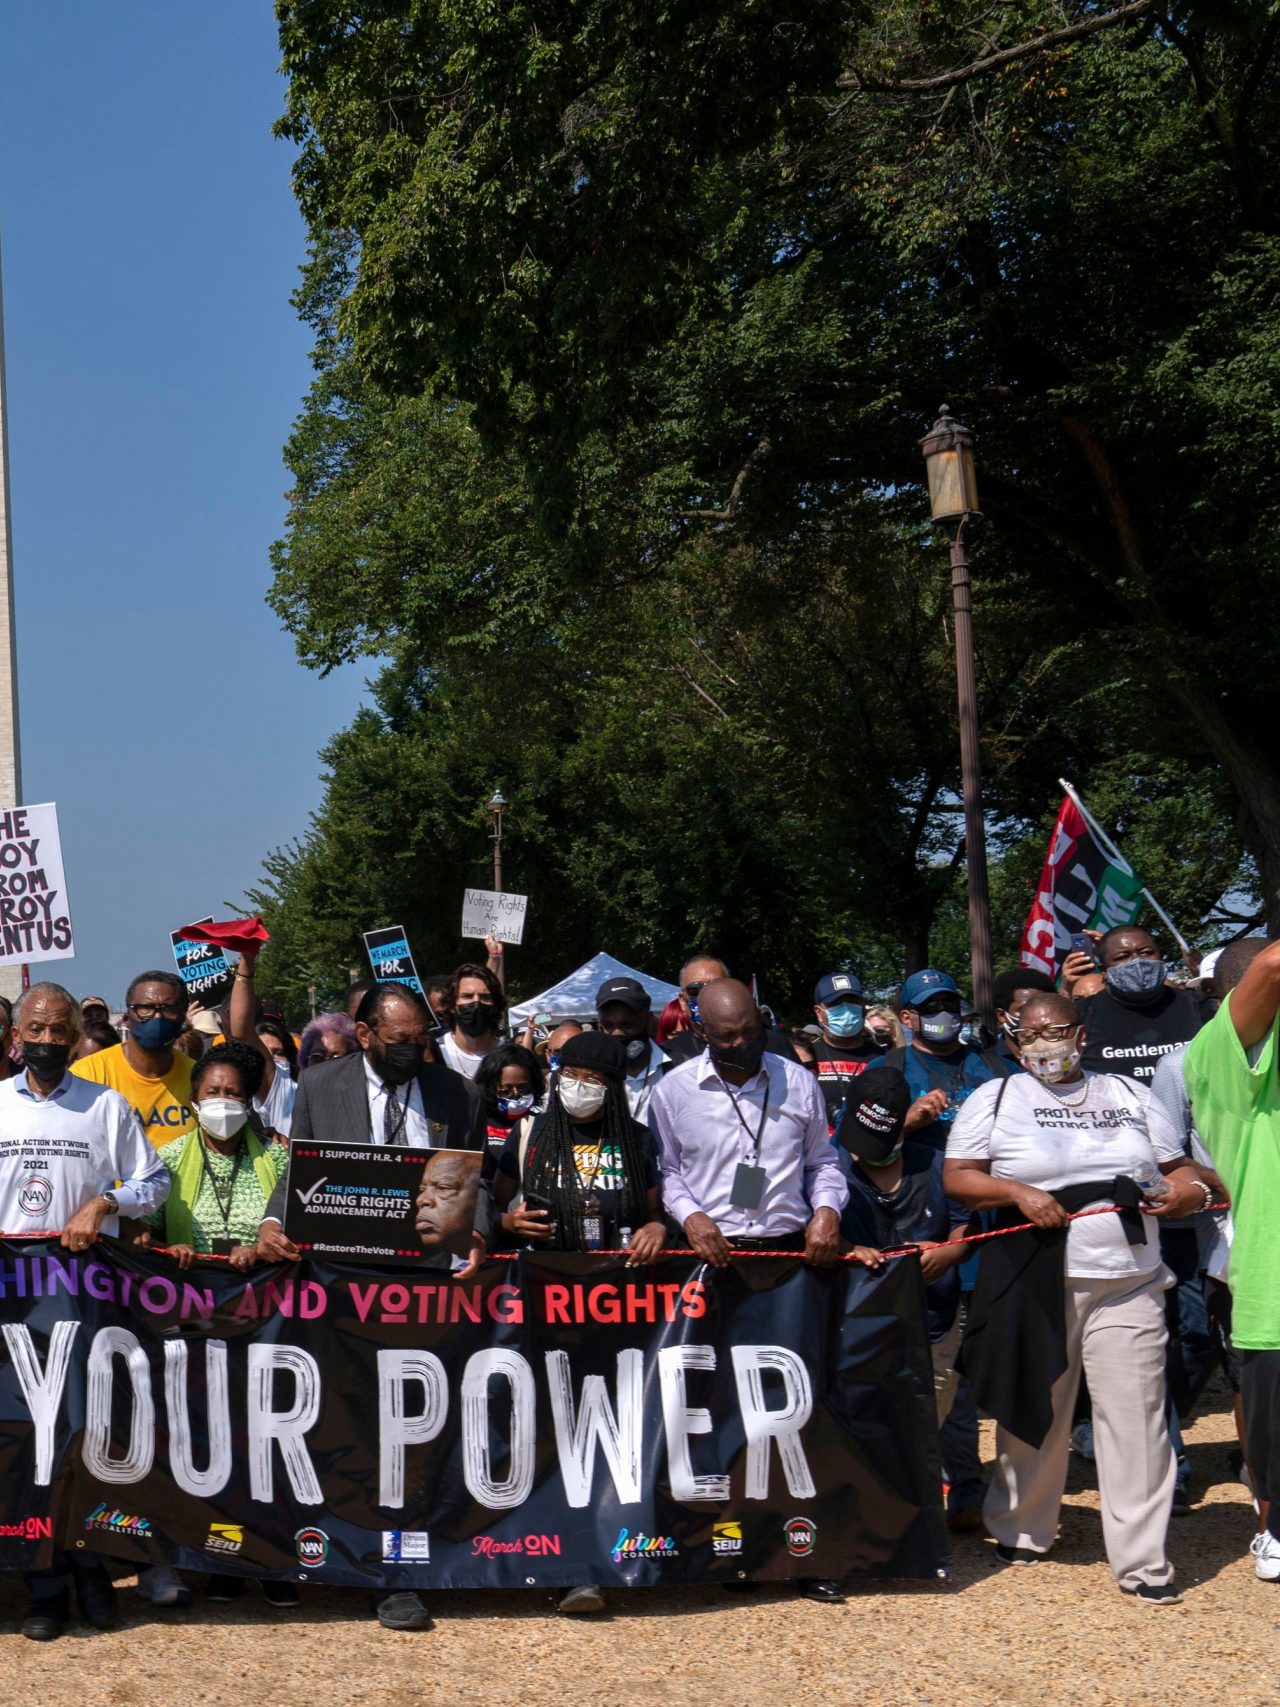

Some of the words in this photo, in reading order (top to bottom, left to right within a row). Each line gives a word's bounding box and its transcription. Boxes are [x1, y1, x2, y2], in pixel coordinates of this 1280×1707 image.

[466, 891, 494, 912] Voting
[498, 894, 525, 915] Rights
[483, 912, 499, 921] Are
[186, 945, 212, 965] FOR
[382, 945, 408, 957] MARCH
[181, 958, 226, 979] VOTING
[380, 959, 405, 977] FOR
[186, 971, 228, 994] RIGHTS
[134, 1105, 191, 1127] AACP
[872, 1103, 890, 1116] PUSH
[1103, 1107, 1132, 1120] OUR
[22, 1139, 51, 1147] ACTION
[52, 1139, 90, 1149] NETWORK
[11, 1149, 19, 1157] ON
[21, 1148, 34, 1156] FOR
[36, 1148, 63, 1156] VOTING
[64, 1149, 90, 1159] RIGHTS
[319, 1150, 324, 1158] I
[325, 1150, 372, 1161] SUPPORT
[373, 1153, 393, 1163] H.R.
[394, 1154, 402, 1163] 4
[23, 1160, 49, 1170] 2021
[22, 1190, 48, 1203] NAN
[325, 1184, 343, 1193] THE
[344, 1186, 368, 1195] JOHN
[370, 1187, 380, 1196] R.
[382, 1188, 410, 1198] LEWIS
[360, 1196, 411, 1210] RIGHTS
[304, 1205, 384, 1218] ADVANCEMENT
[386, 1209, 408, 1219] ACT
[312, 1243, 395, 1256] #RestoreTheVote
[235, 1282, 328, 1324] AND
[348, 1283, 525, 1325] VOTING
[545, 1281, 707, 1324] RIGHTS
[1, 1320, 325, 1506] YOUR
[376, 1343, 817, 1509] POWER
[95, 1521, 153, 1538] COALITION
[789, 1532, 811, 1543] NAN
[205, 1538, 242, 1551] SEIU
[300, 1542, 323, 1554] NAN
[471, 1536, 524, 1559] March
[611, 1528, 675, 1563] future
[713, 1539, 742, 1551] SEIU
[622, 1550, 680, 1559] COALITION
